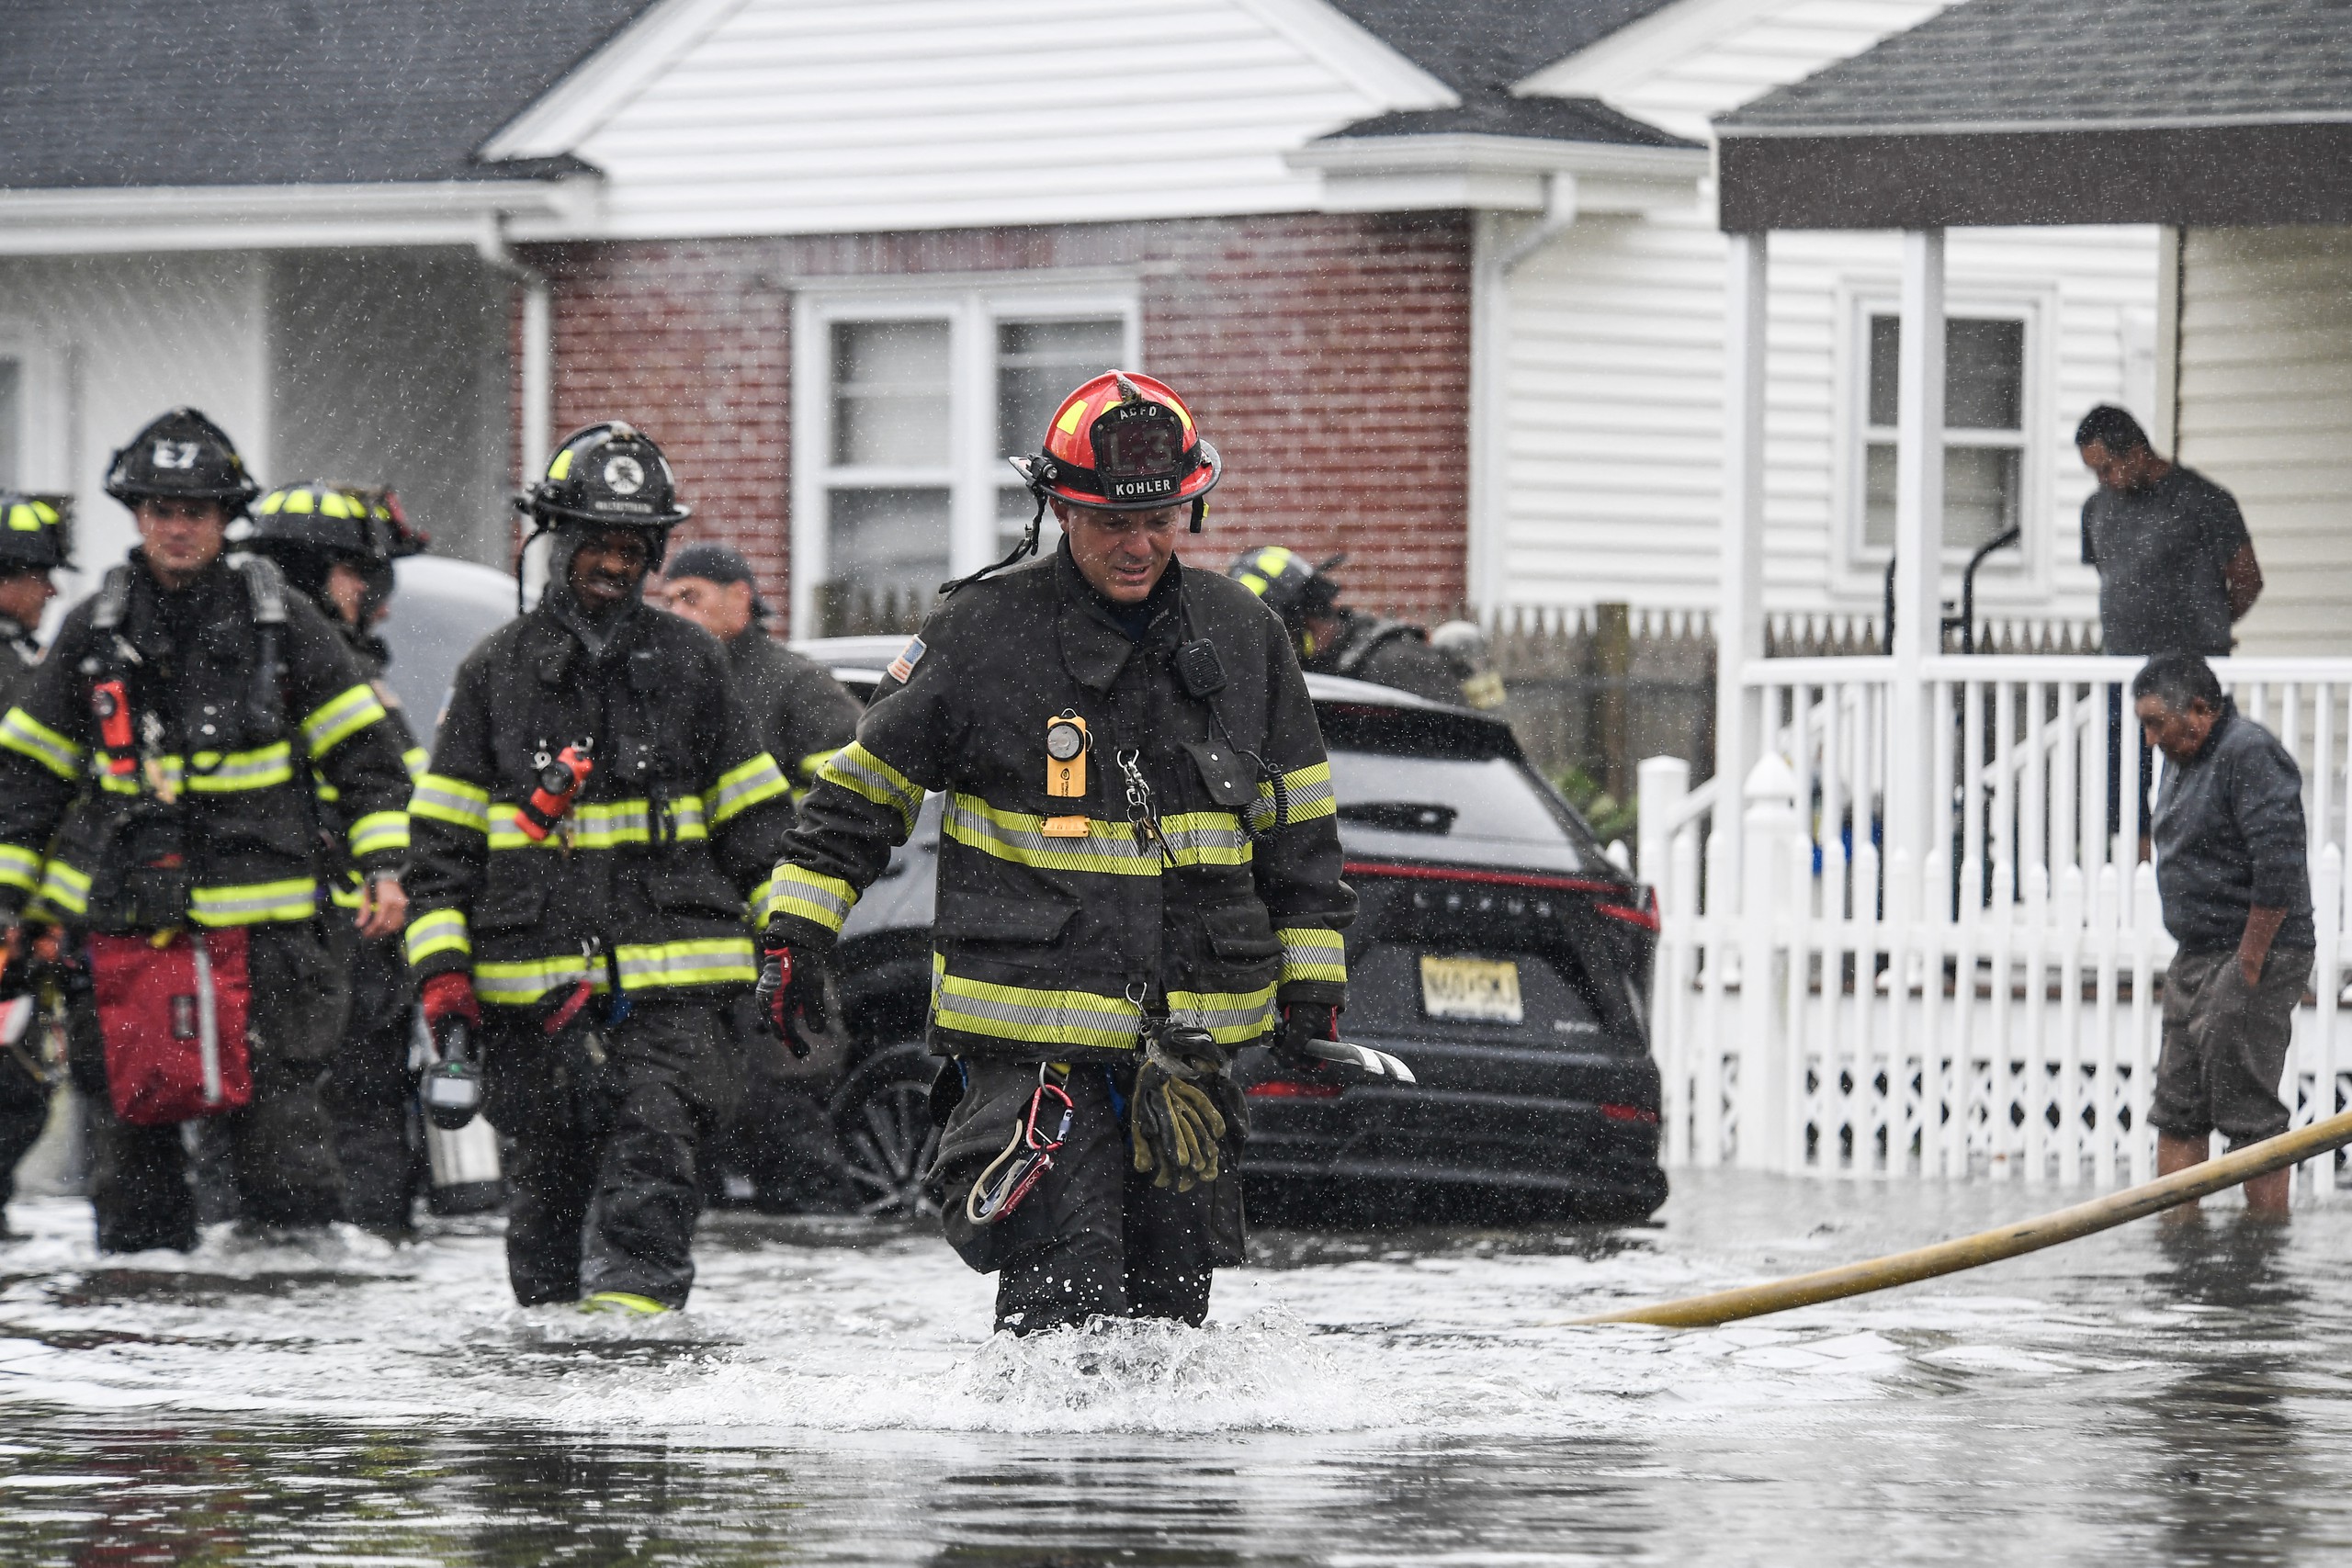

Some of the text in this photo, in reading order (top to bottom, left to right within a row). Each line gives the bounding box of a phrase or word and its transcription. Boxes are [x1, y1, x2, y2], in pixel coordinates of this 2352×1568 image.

[1120, 405, 1157, 420] ACFD
[153, 440, 199, 468] E7
[1115, 479, 1170, 496] KOHLER
